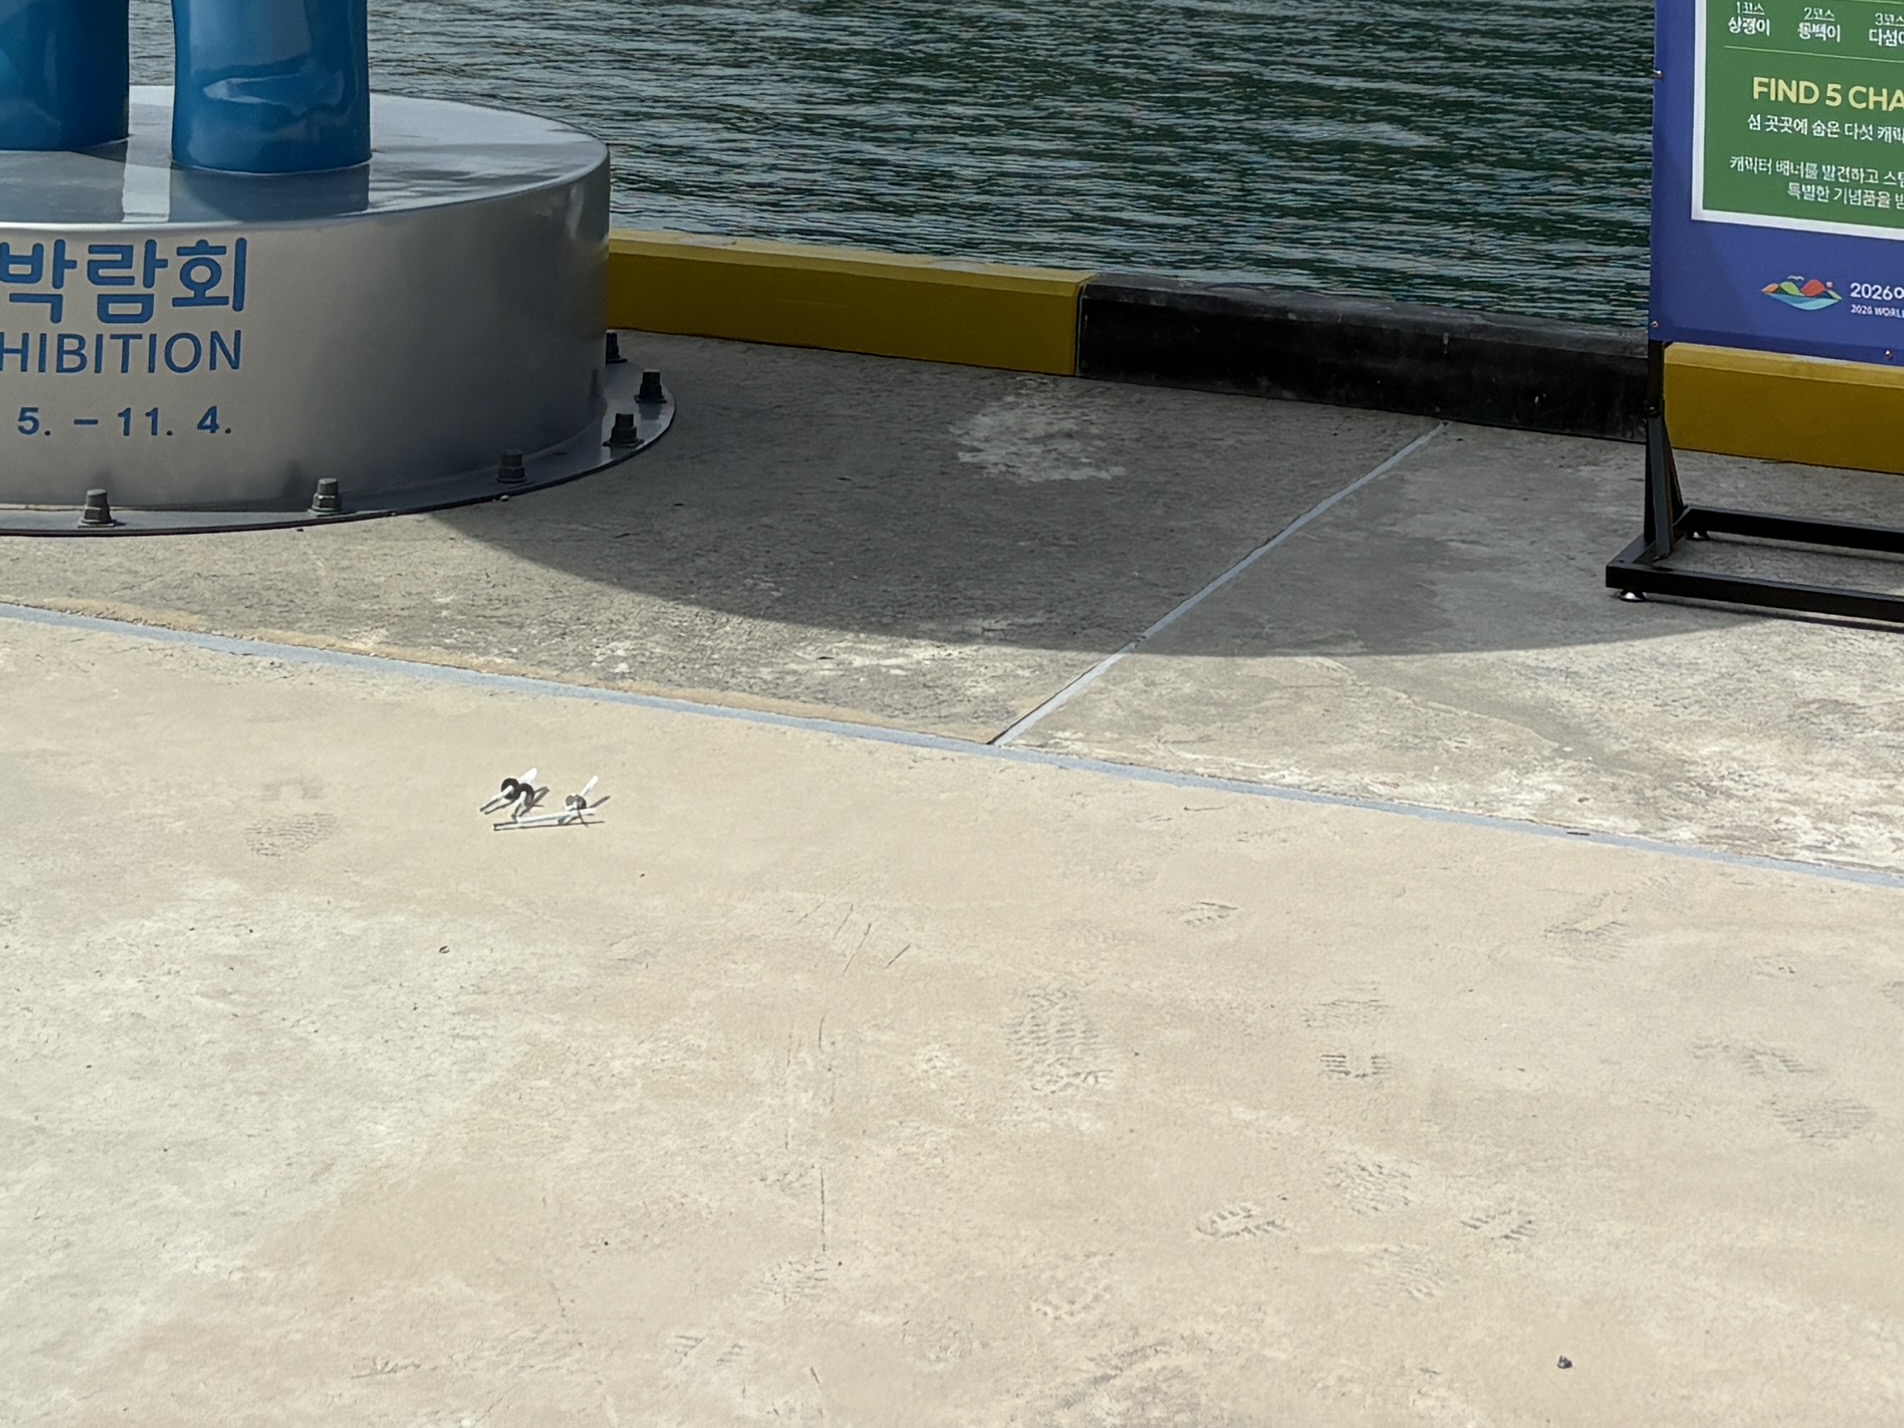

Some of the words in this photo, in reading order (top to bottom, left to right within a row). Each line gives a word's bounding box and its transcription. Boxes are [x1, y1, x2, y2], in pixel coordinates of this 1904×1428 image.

[1752, 77, 1819, 105] FIND
[1826, 84, 1842, 107] 5
[1765, 115, 1808, 135] 곳곳에
[1844, 123, 1874, 141] 다섯
[1730, 156, 1772, 175] 캐릭터
[1788, 182, 1830, 202] 특별한
[1834, 187, 1891, 208] 기념품을
[17, 407, 51, 436] 5.
[118, 407, 174, 436] 11.
[197, 405, 232, 435] 4.
